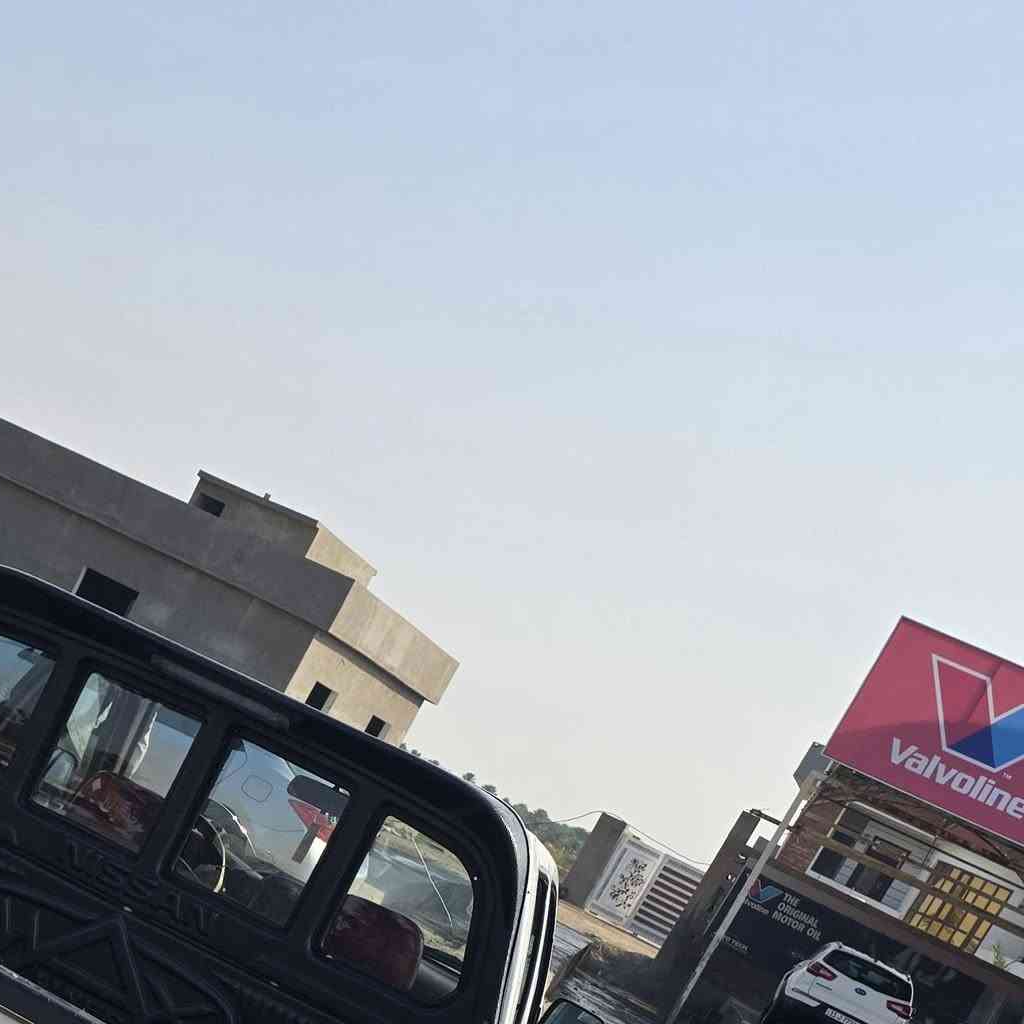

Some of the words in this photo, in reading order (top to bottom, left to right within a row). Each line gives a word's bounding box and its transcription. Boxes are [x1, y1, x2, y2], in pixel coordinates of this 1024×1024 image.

[891, 737, 1024, 820] Valvoline
[784, 892, 801, 907] THE
[772, 911, 806, 933] MOTOR
[807, 927, 822, 940] OIL
[777, 902, 819, 929] ORIGINAL
